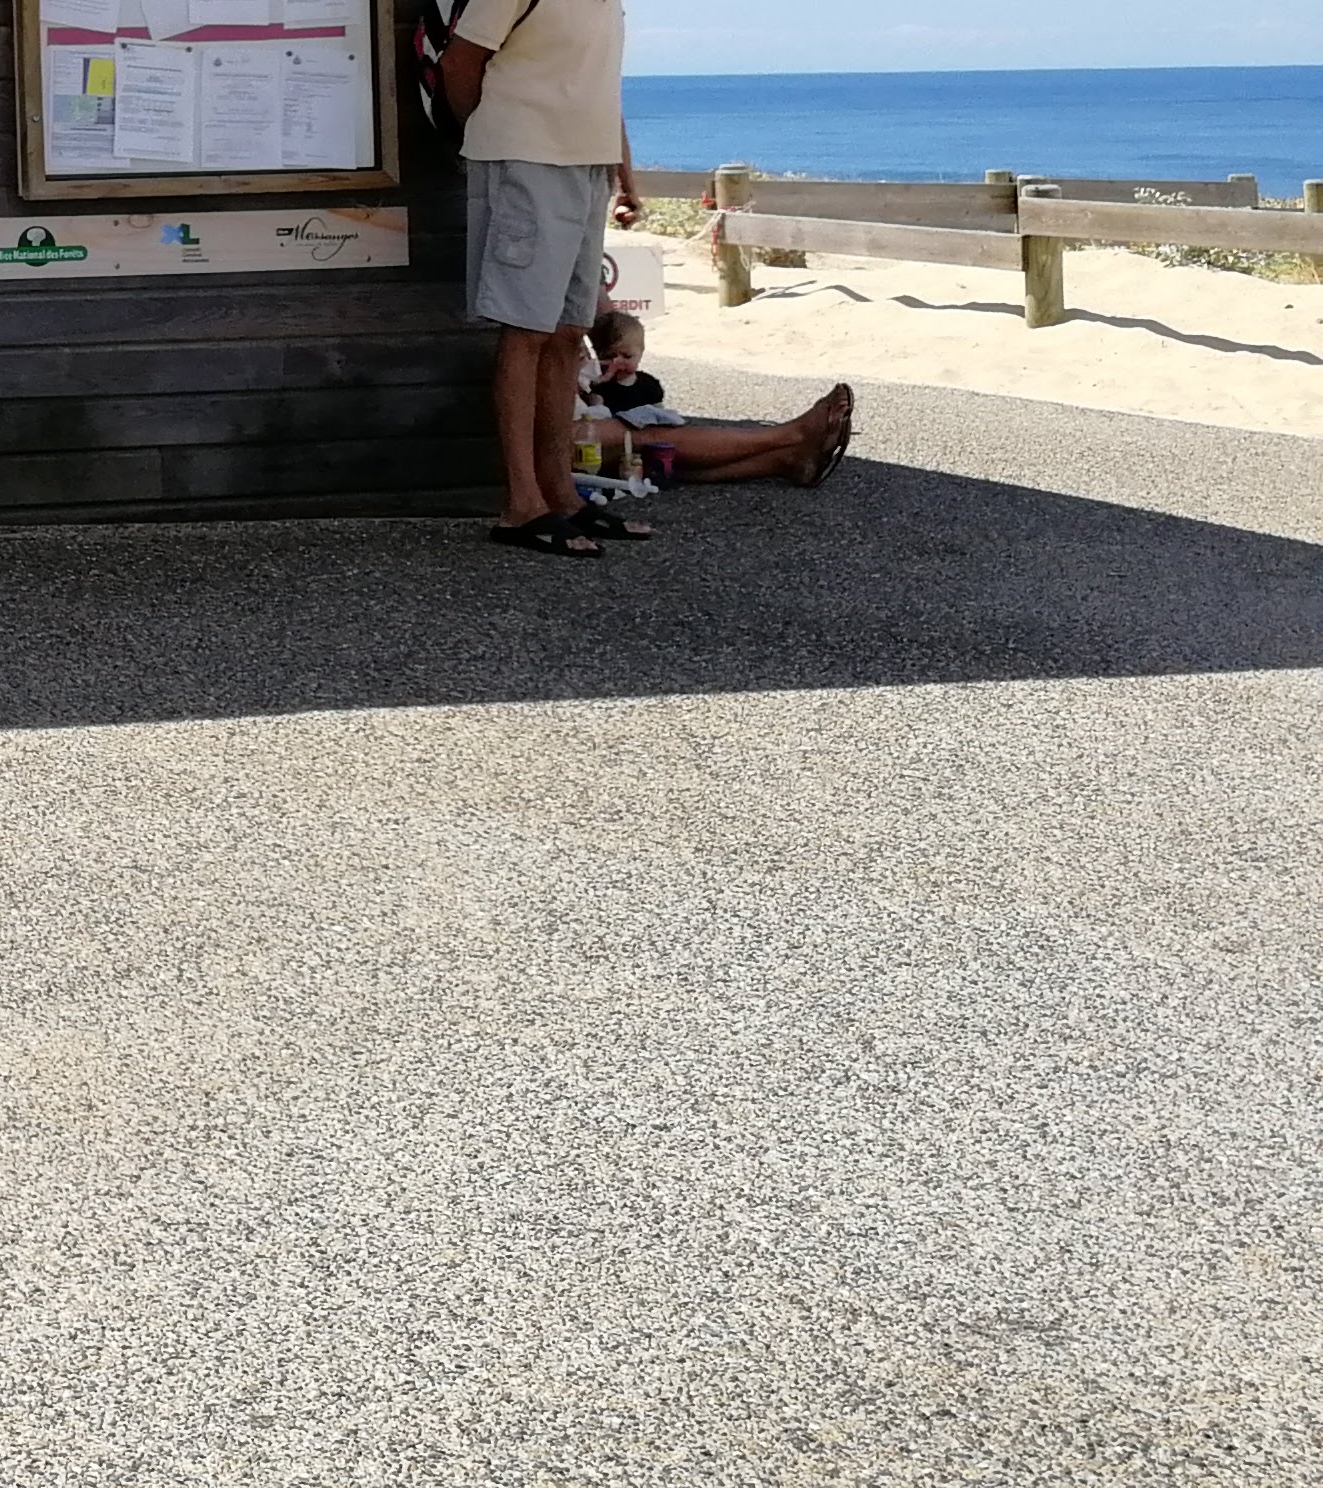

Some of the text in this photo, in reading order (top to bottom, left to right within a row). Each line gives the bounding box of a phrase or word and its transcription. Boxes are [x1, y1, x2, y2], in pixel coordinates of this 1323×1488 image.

[13, 250, 46, 260] National
[46, 249, 59, 259] des
[612, 299, 652, 311] ERDIT
